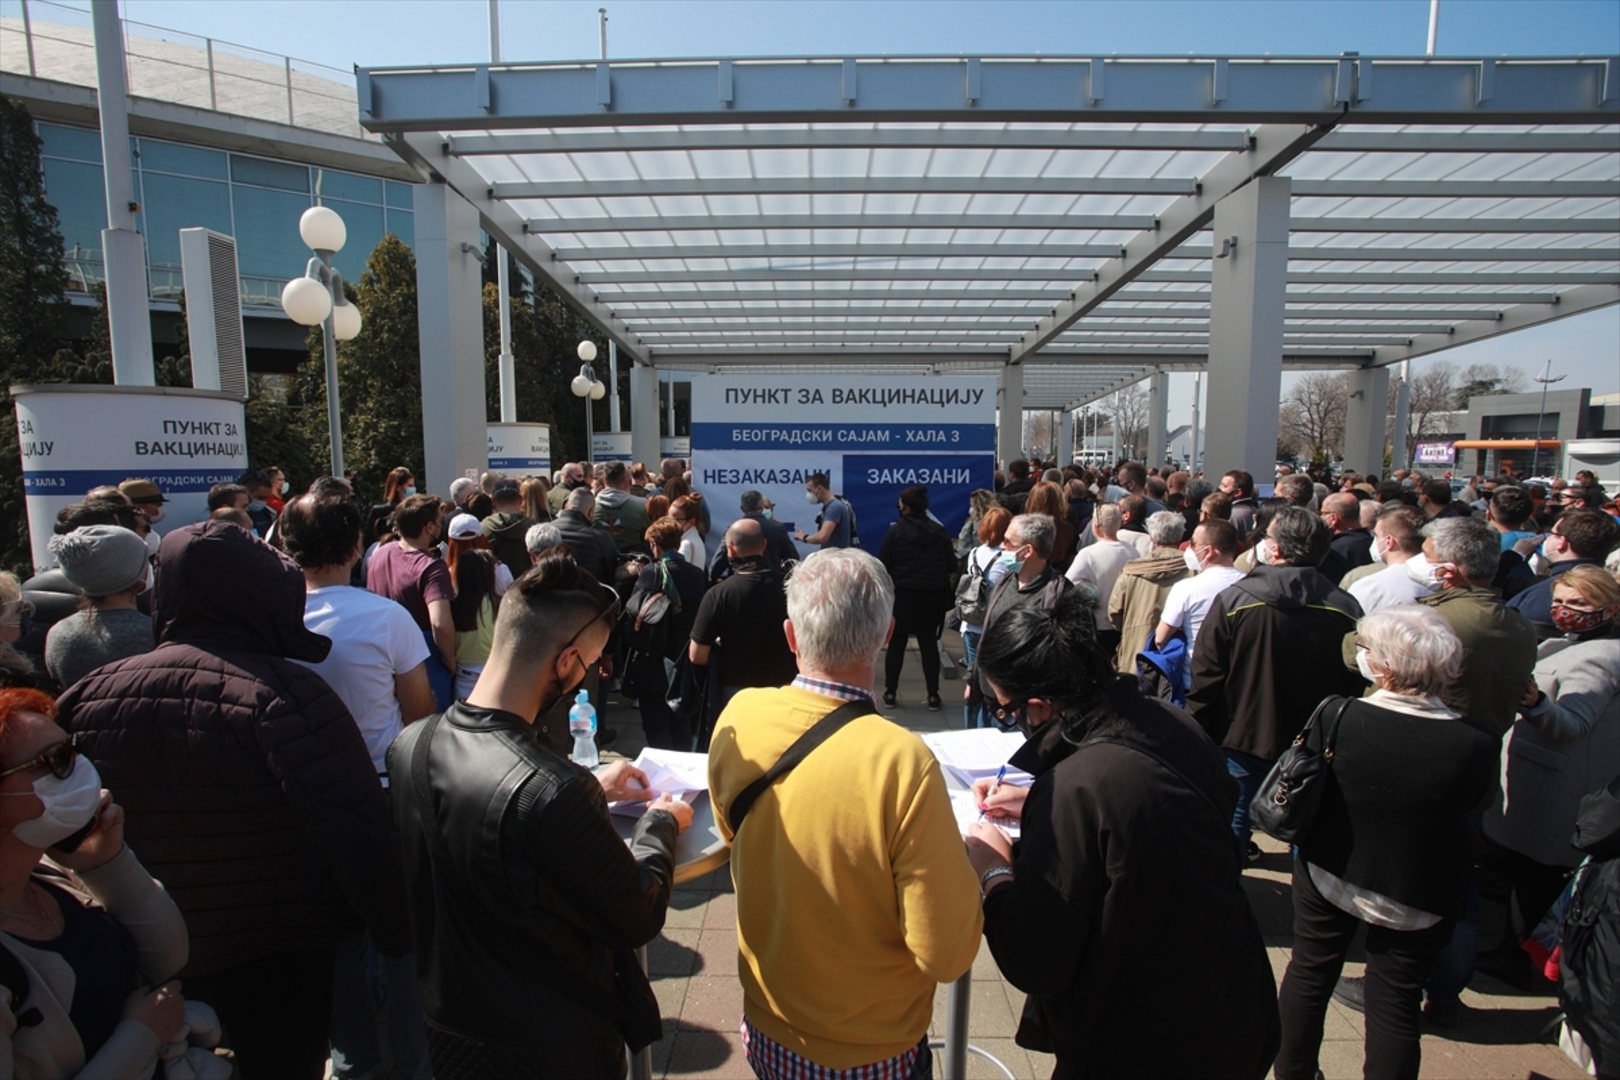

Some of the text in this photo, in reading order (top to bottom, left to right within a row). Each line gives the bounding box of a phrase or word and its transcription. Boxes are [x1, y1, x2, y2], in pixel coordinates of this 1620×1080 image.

[725, 388, 984, 408] ПУНКТ ЗА ВАКЦИНАЦИЈУ
[162, 420, 238, 437] ПУНКТ ЗА
[732, 429, 833, 445] БЕОГРАДСКИ
[837, 429, 890, 442] САЈАМ
[905, 429, 946, 442] ХАЛА
[951, 429, 960, 442] 3
[126, 475, 205, 487] ГРАДСКИ
[206, 475, 234, 484] САЈАМ
[867, 468, 970, 484] ЗАКАЗАНИ
